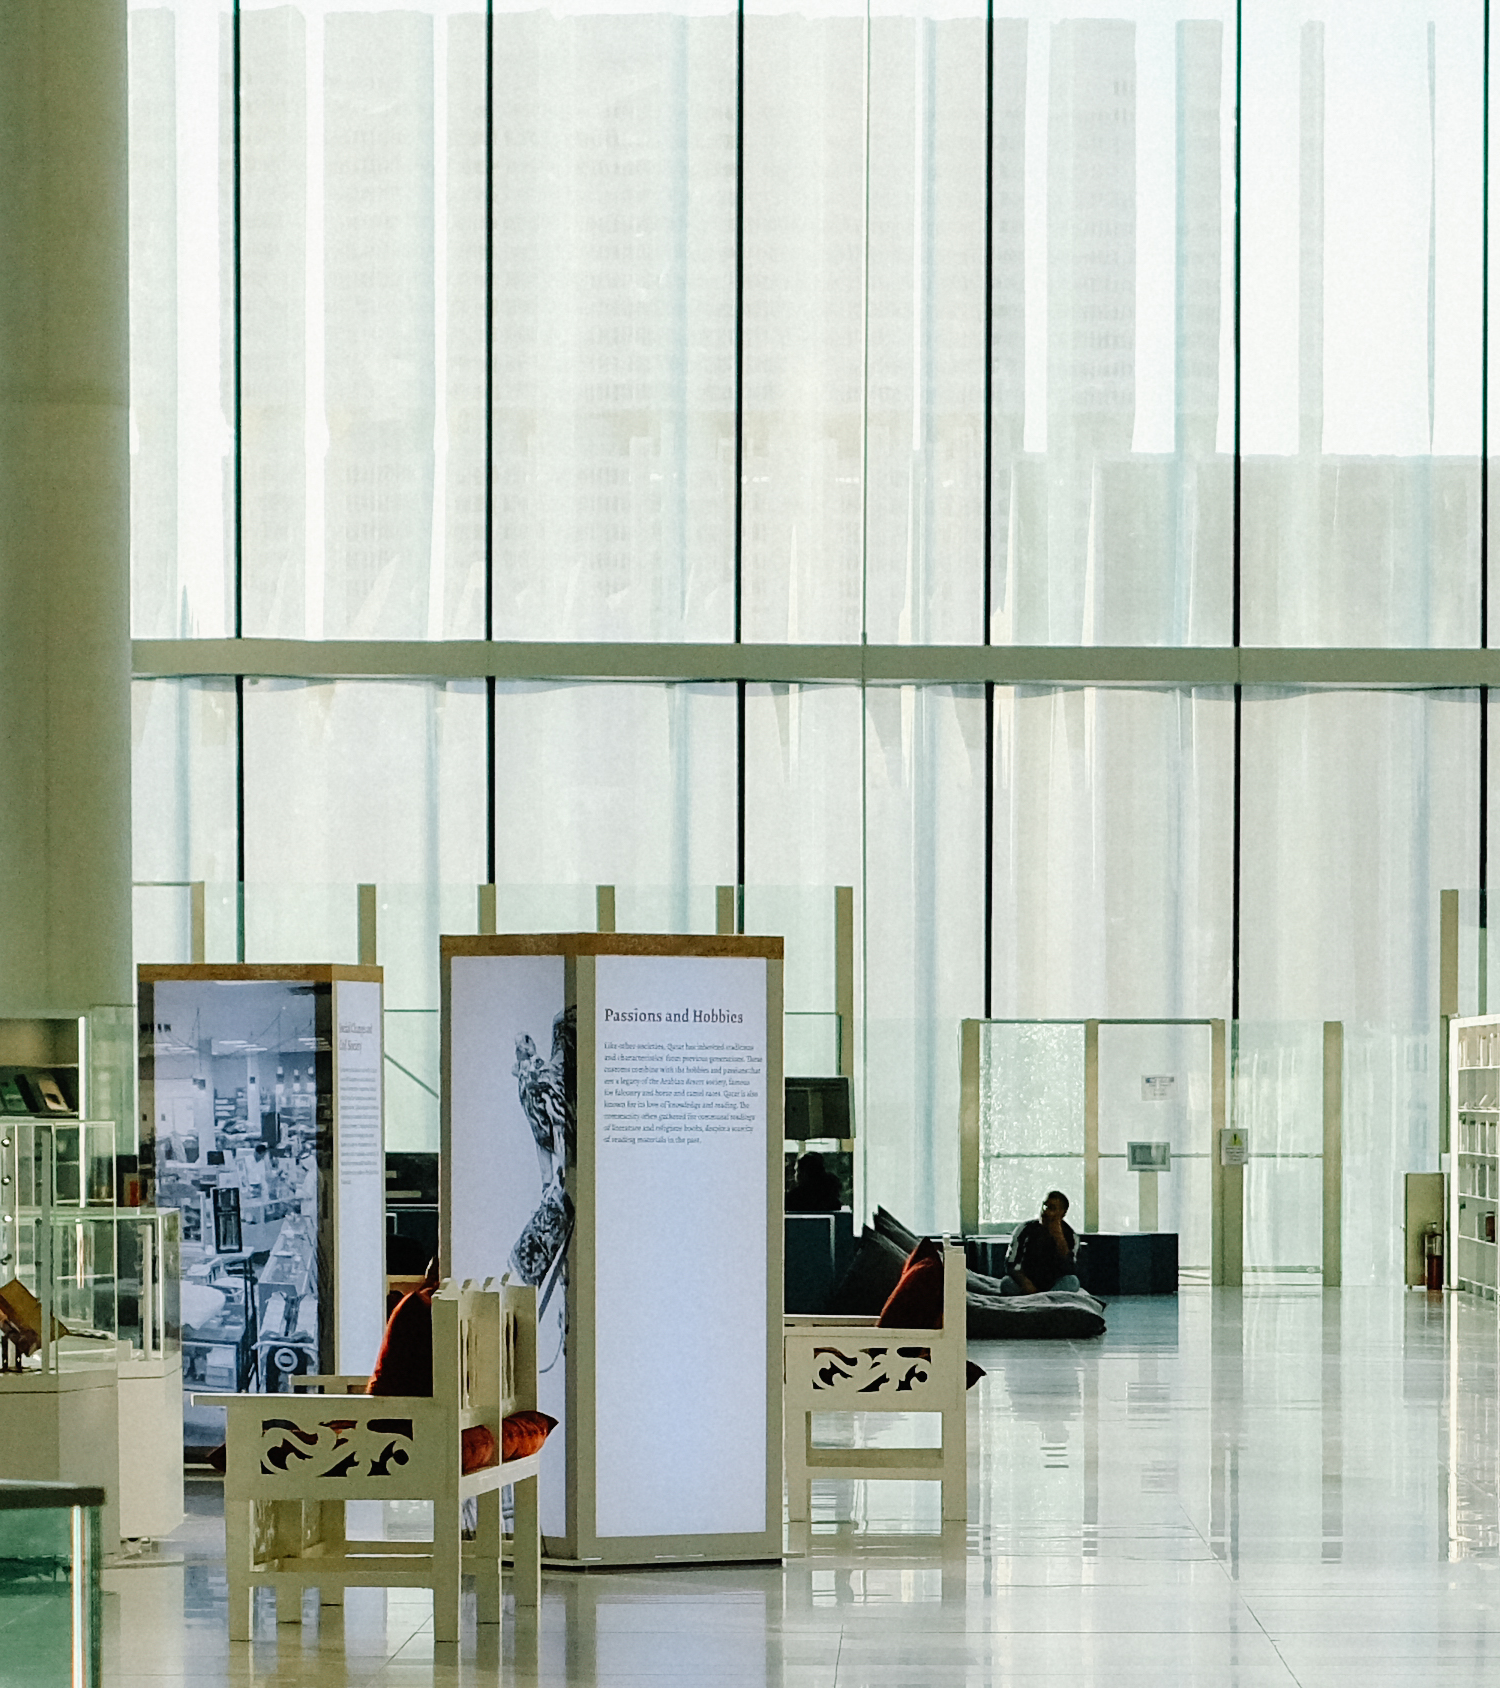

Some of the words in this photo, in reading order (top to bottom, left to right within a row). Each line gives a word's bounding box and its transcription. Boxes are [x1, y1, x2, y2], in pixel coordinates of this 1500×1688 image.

[604, 1008, 662, 1023] Passions
[666, 1008, 689, 1023] and
[692, 1008, 743, 1023] Hobbies
